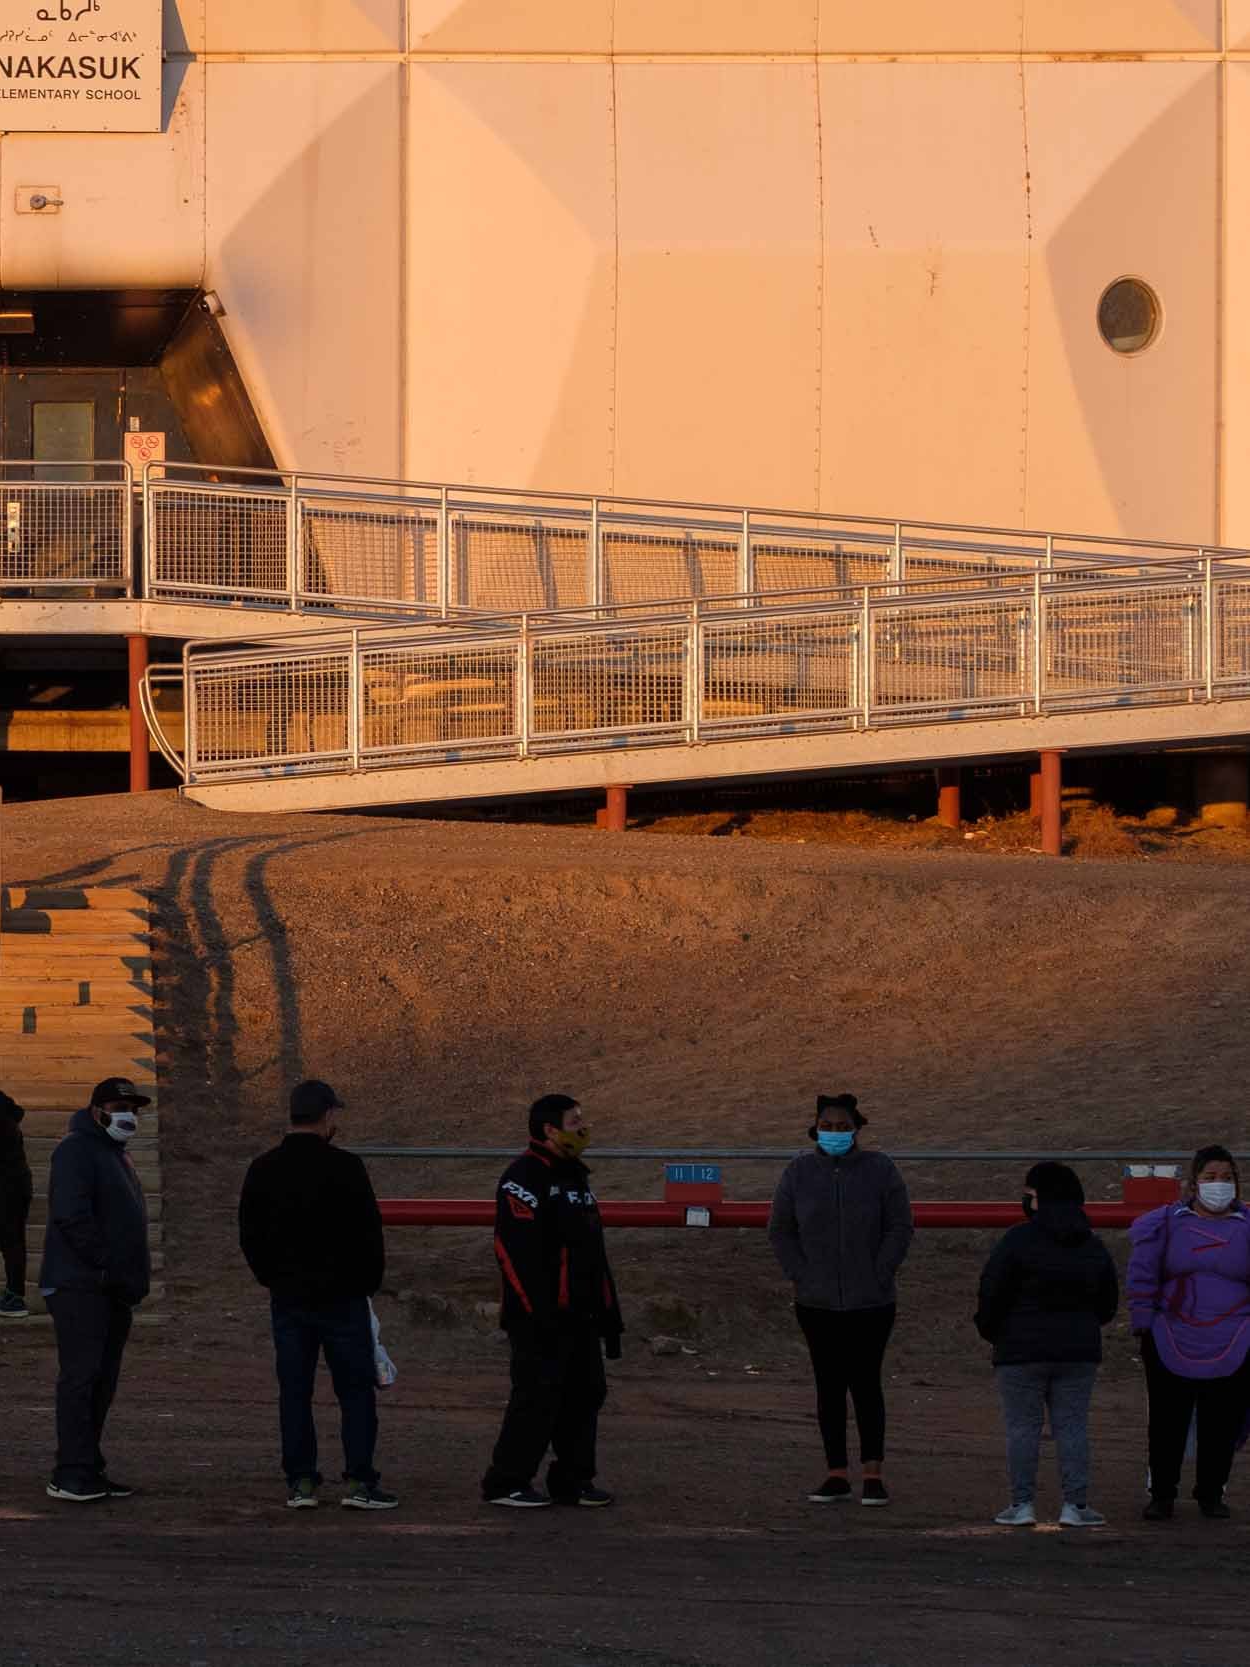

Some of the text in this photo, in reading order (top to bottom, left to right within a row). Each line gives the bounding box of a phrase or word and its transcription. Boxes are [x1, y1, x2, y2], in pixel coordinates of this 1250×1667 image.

[85, 88, 142, 101] SCHOOL
[701, 1167, 714, 1180] 12
[501, 1181, 539, 1208] FXR
